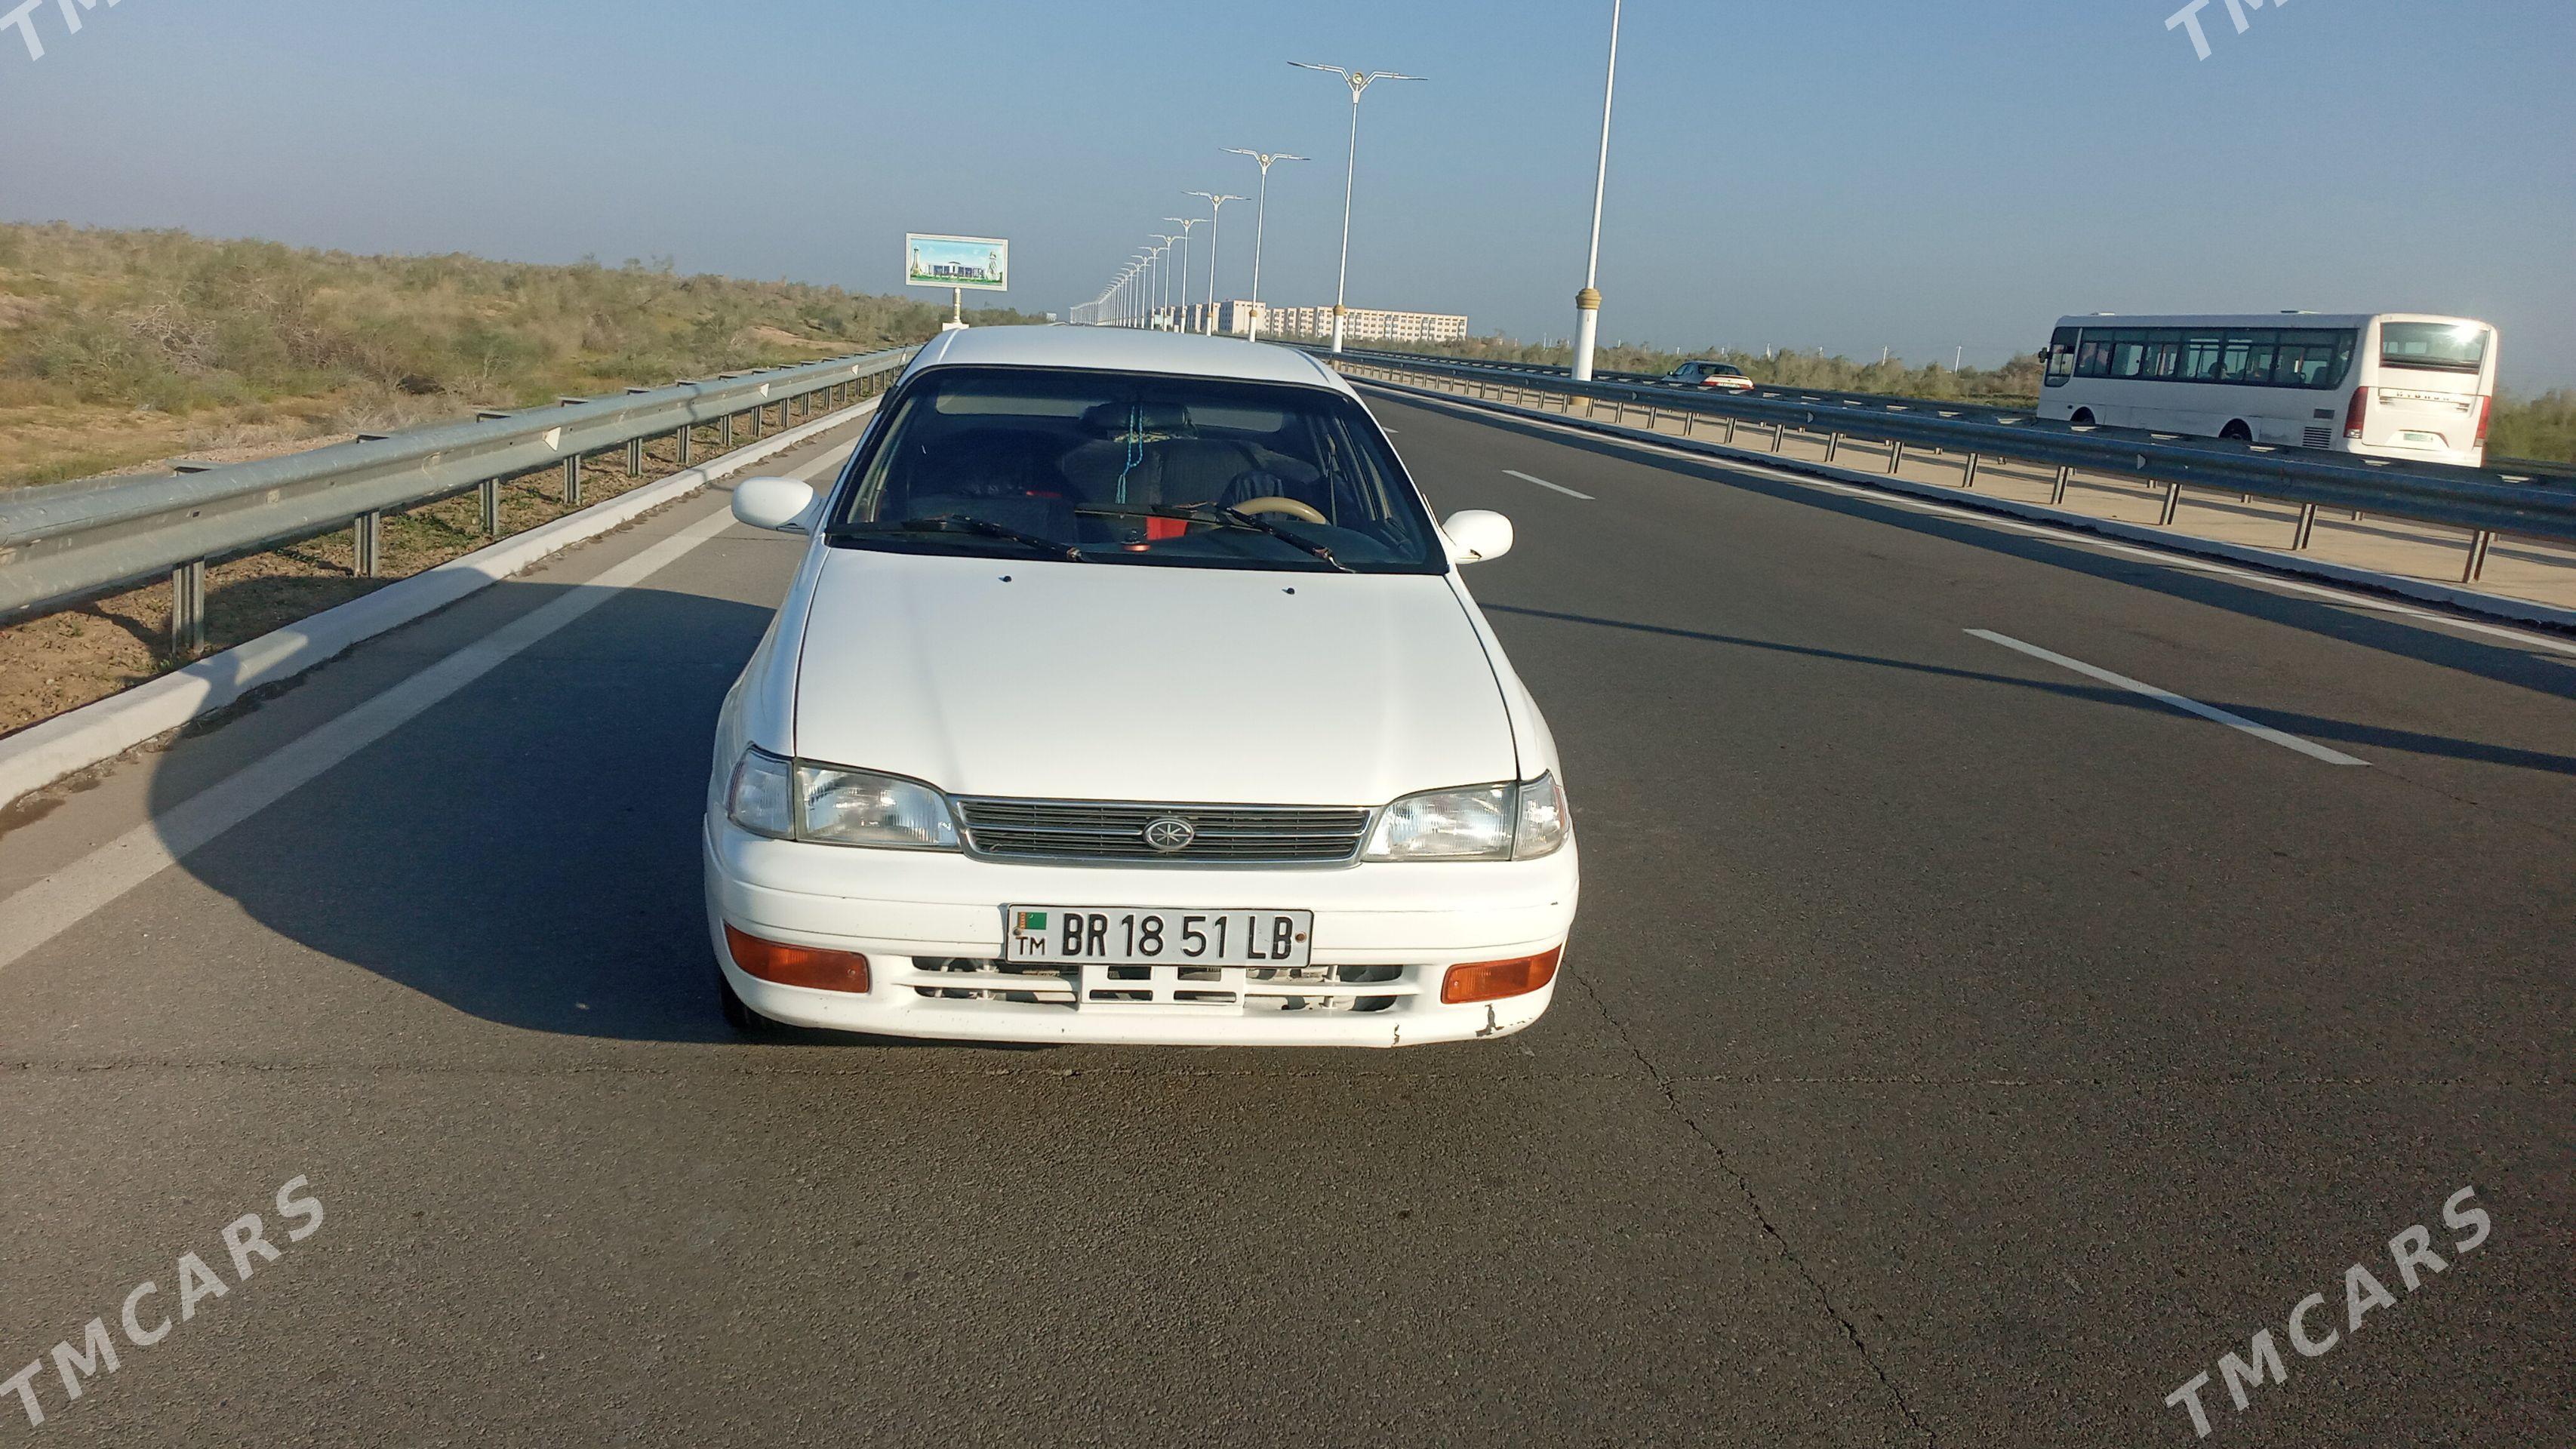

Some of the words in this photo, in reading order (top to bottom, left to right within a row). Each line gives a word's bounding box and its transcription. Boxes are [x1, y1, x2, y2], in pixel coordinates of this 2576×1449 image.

[1015, 936, 1046, 956] TM
[1062, 912, 1108, 957] BR
[1121, 914, 1165, 958] 18
[1181, 915, 1228, 958] 51
[1247, 915, 1294, 961] LB
